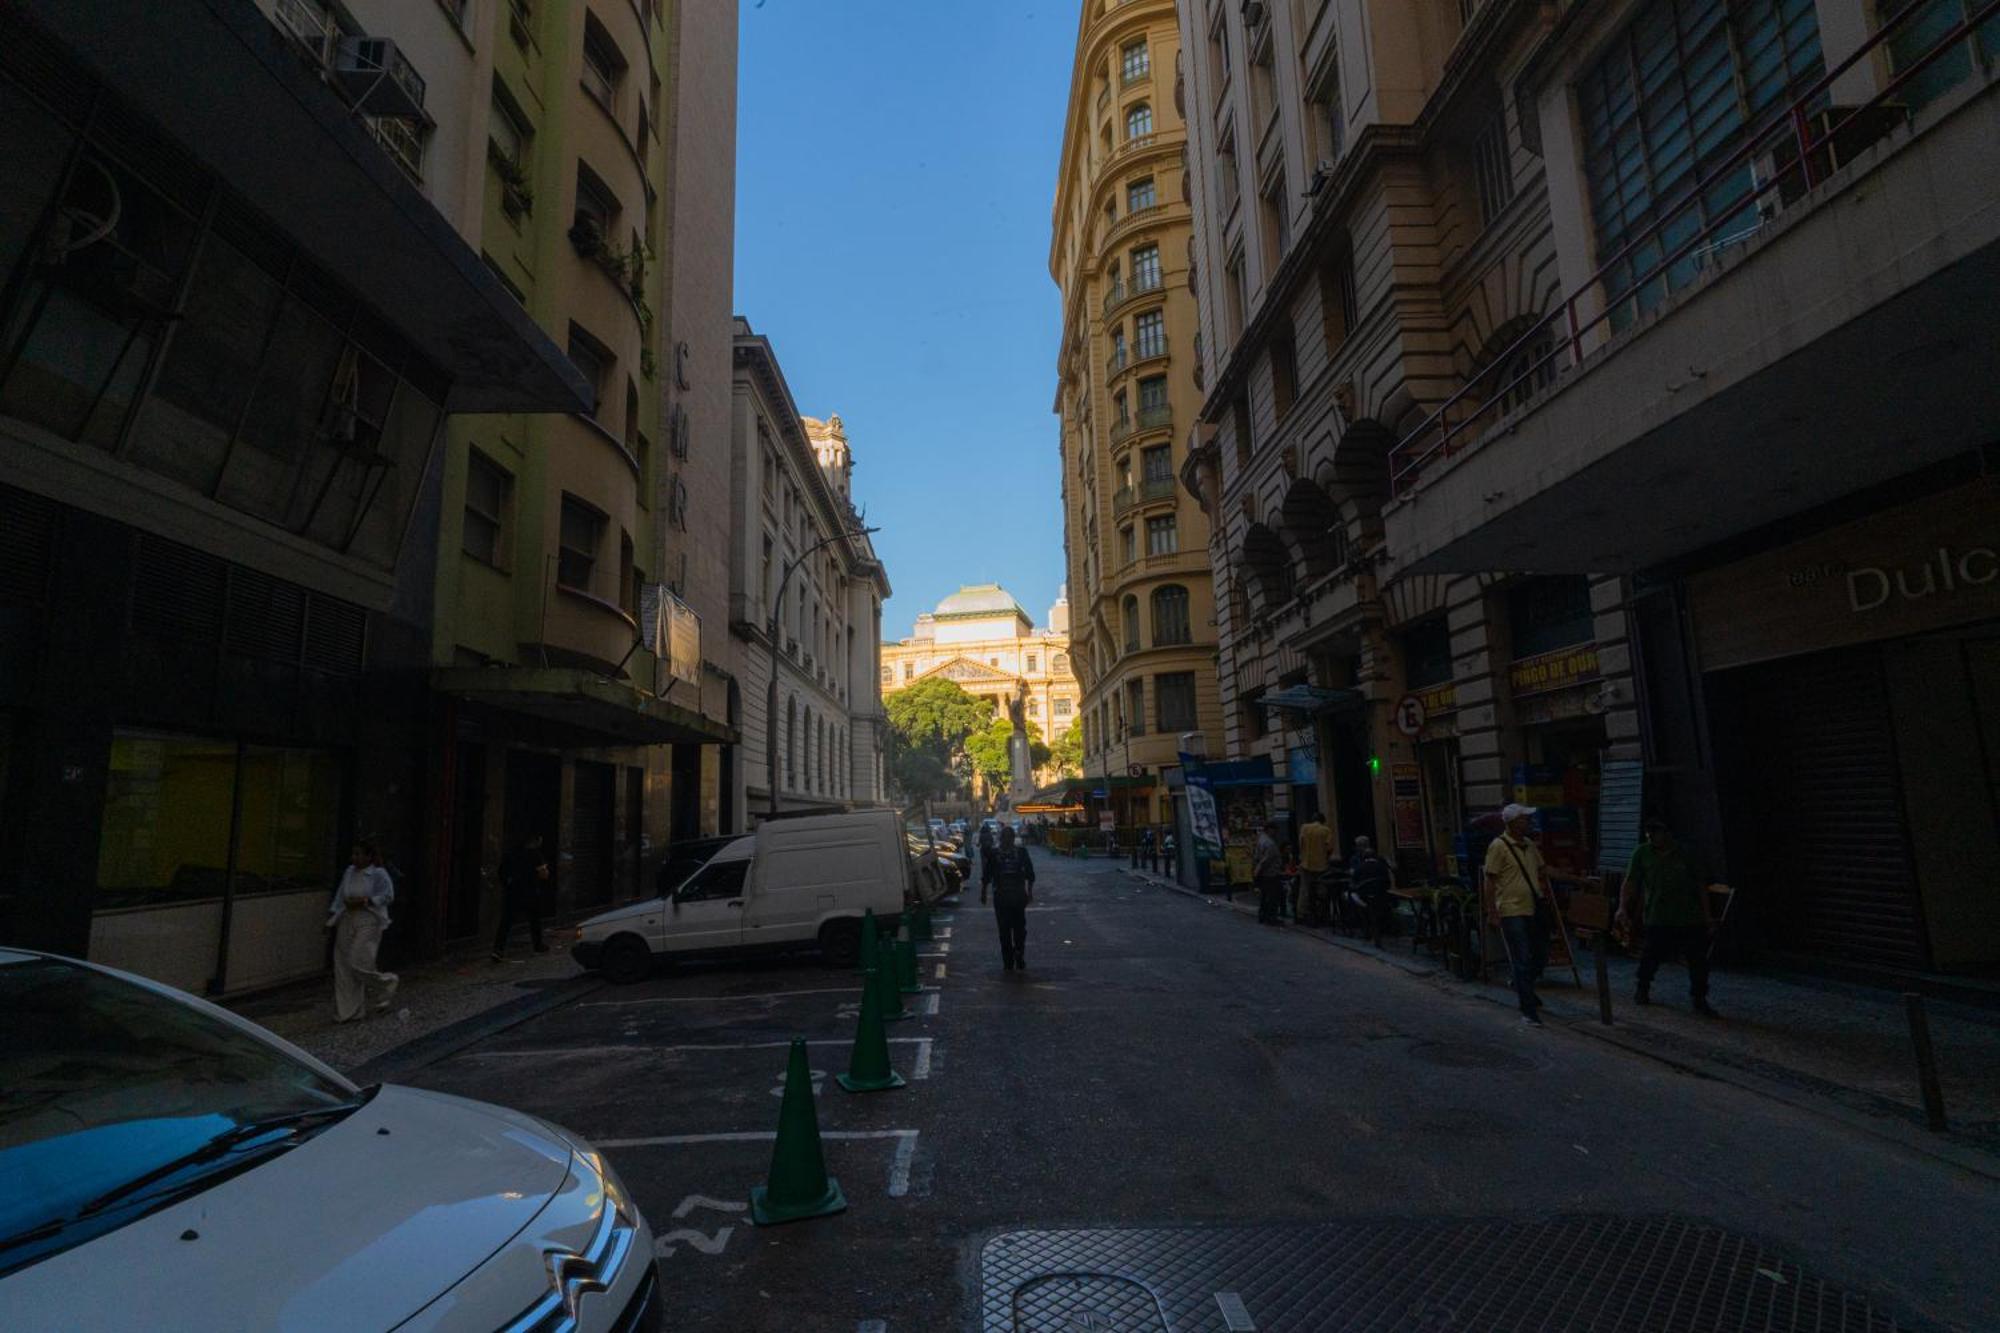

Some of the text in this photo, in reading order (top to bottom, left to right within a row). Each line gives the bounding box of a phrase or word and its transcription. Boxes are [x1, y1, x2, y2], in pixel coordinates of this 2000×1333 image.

[1846, 547, 2000, 612] Dulc
[1550, 659, 1564, 679] DE
[653, 1194, 748, 1257] 27
